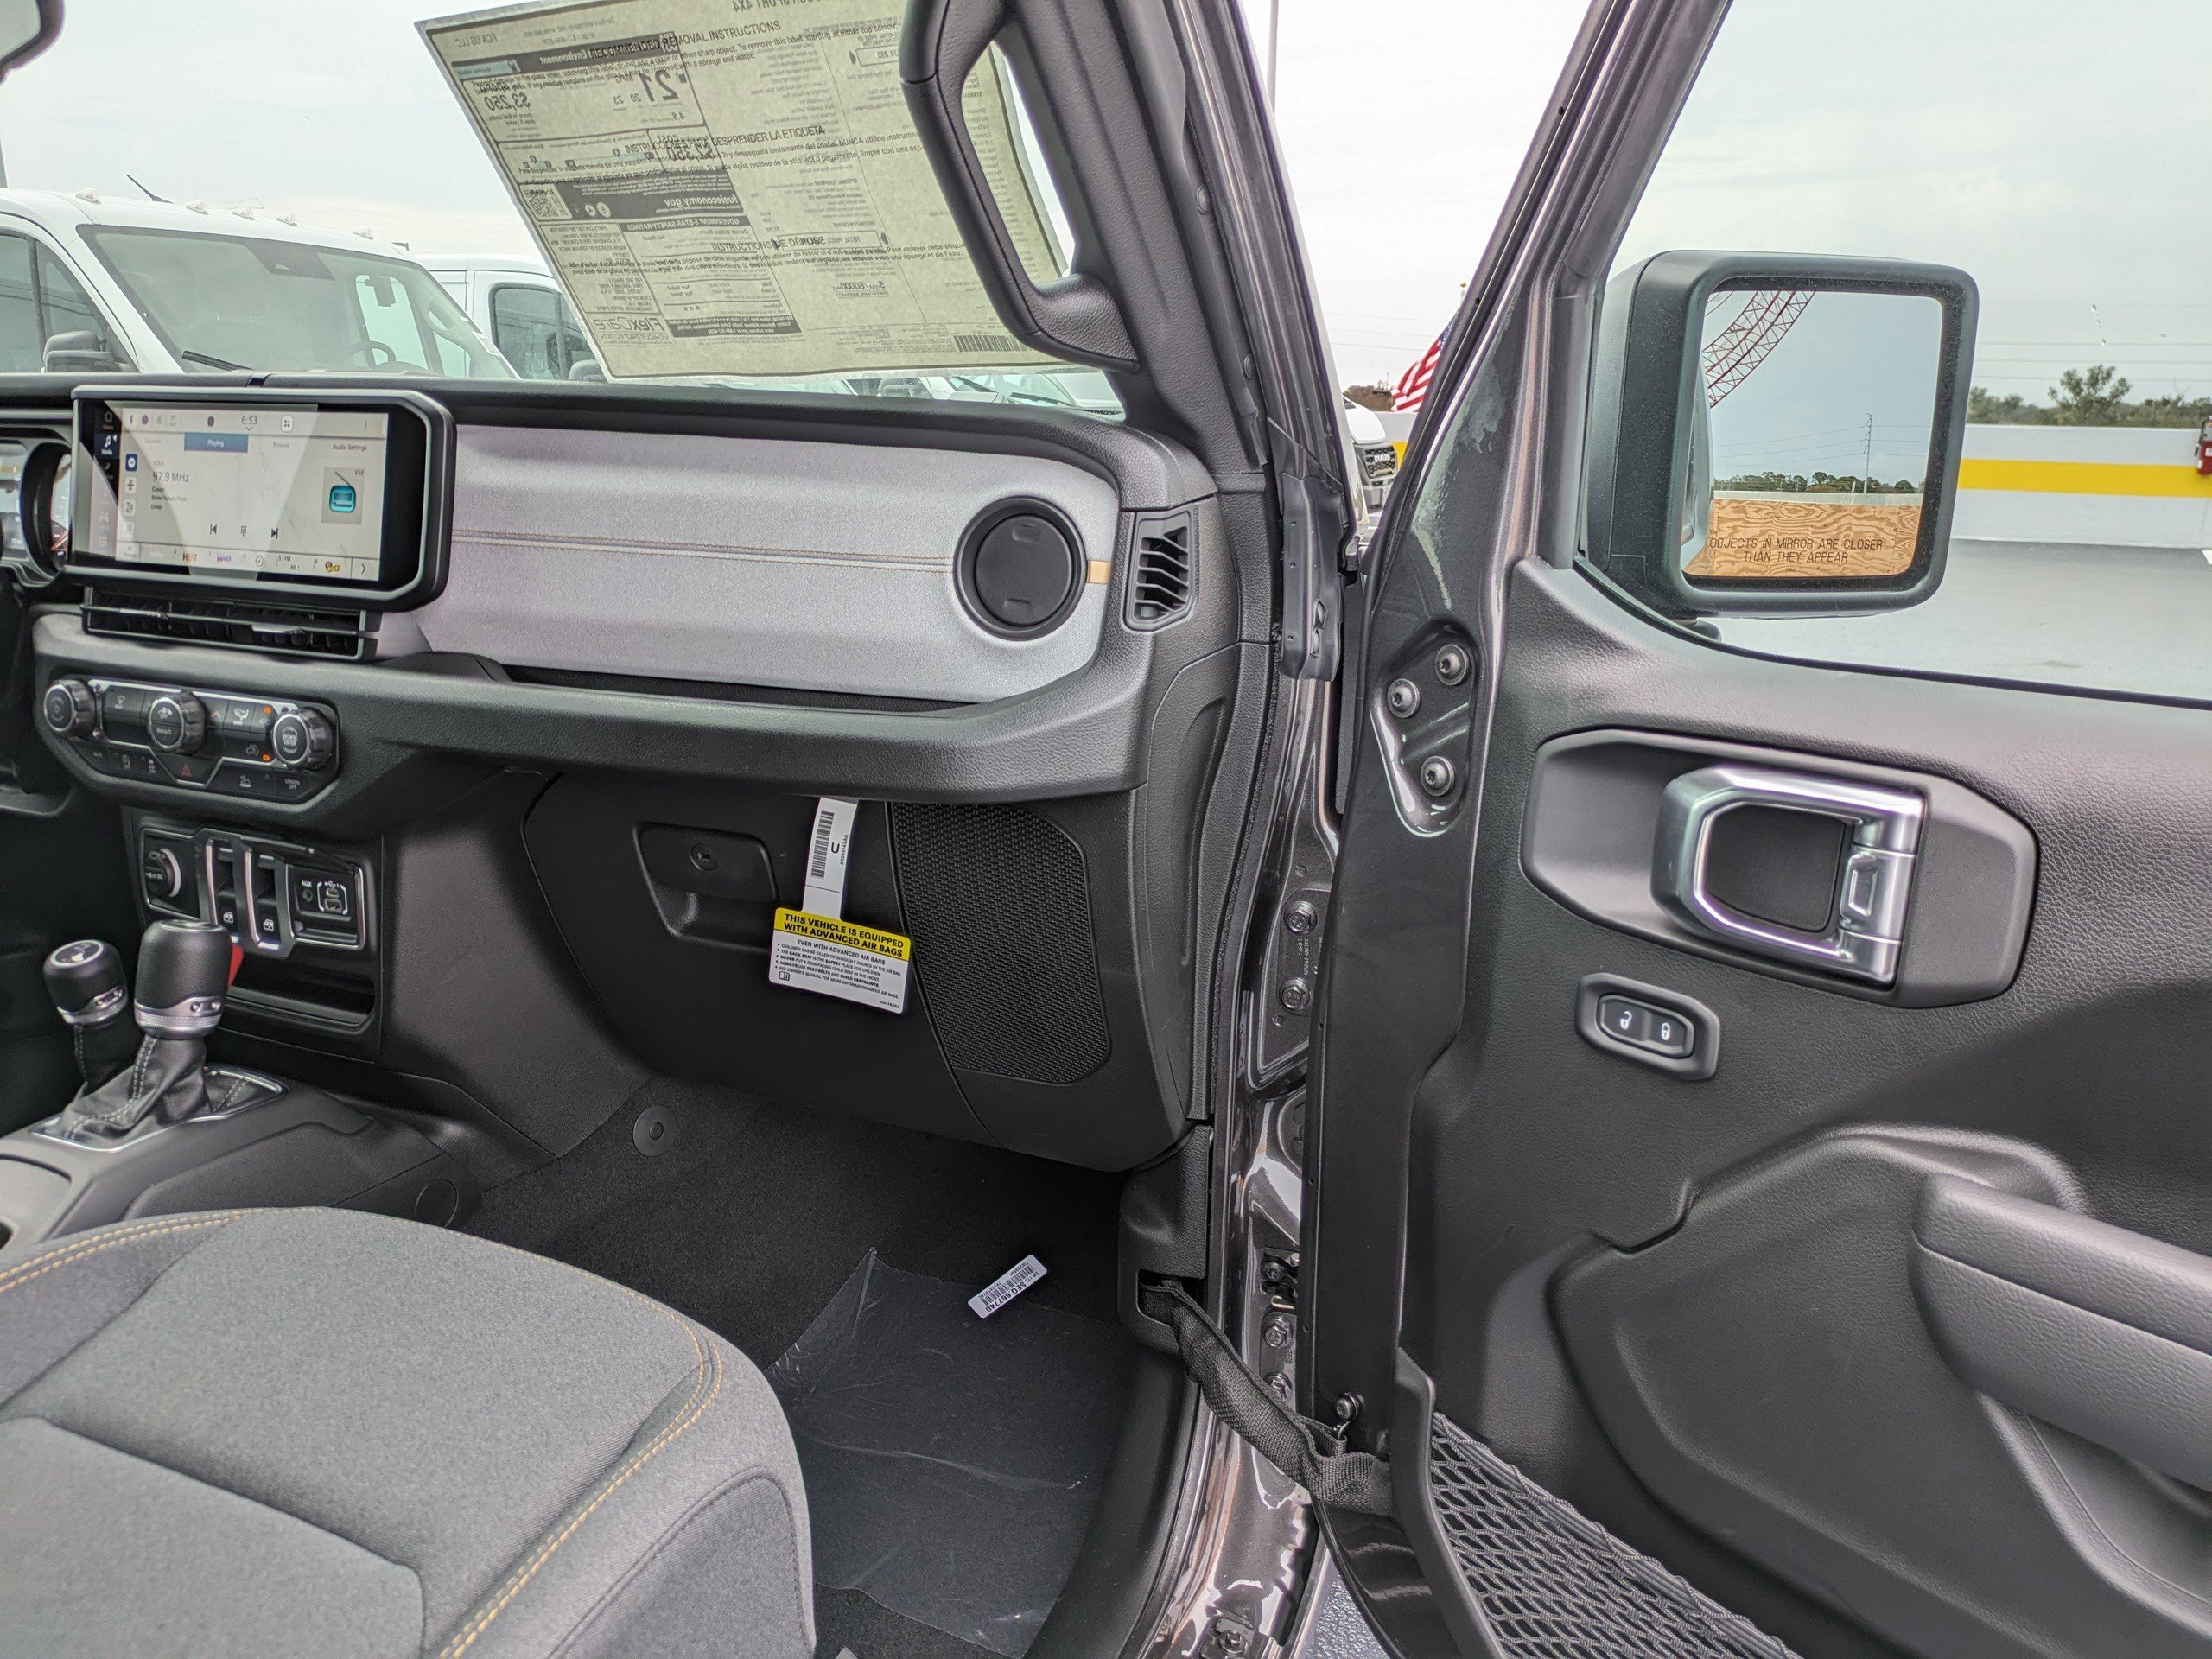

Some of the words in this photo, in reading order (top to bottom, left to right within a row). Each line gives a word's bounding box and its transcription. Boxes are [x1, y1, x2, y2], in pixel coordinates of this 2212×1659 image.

[591, 38, 660, 58] RECOMMENDED
[662, 30, 709, 48] REMOVAL
[709, 20, 781, 41] INSTRUCTIONS
[698, 48, 715, 58] sharp
[716, 42, 737, 56] object.
[737, 41, 747, 52] To
[747, 40, 772, 49] remove
[787, 34, 804, 44] label,
[805, 30, 831, 43] starting
[841, 27, 859, 35] either
[860, 26, 873, 35] top
[699, 58, 721, 67] sponge
[713, 131, 768, 146] DESPRENDER
[769, 130, 782, 140] LA
[783, 124, 825, 139] ETIQUETA
[770, 143, 804, 153] lentamente
[839, 137, 863, 146] NUNCA
[866, 133, 885, 143] utilice
[733, 162, 749, 170] algún
[789, 155, 815, 164] etiqueta
[860, 148, 880, 157] limpie
[711, 241, 772, 251] INSTRUCTIONS
[788, 234, 826, 245] DÉPOSE
[152, 471, 169, 481] 97.9
[172, 473, 189, 482] MHz
[1709, 537, 1758, 548] OBJECTS
[1762, 538, 1771, 548] IN
[1777, 538, 1814, 549] MIRROR
[1819, 539, 1838, 550] ARE
[1844, 539, 1883, 550] CLOSER
[1744, 551, 1771, 562] THAN
[1777, 551, 1802, 563] THEY
[1806, 552, 1848, 563] APPEAR
[831, 842, 840, 854] U
[784, 922, 808, 934] WITH
[810, 928, 860, 946] ADVANCED
[861, 939, 877, 950] AIR
[879, 944, 903, 956] BAGS
[785, 912, 805, 925] THIS
[808, 918, 846, 934] VEHICLE
[849, 928, 857, 937] IS
[859, 930, 904, 947] EQUIPPED
[798, 938, 812, 947] EVEN
[813, 943, 828, 951] WITH
[830, 946, 859, 958] ADVANCED
[871, 956, 885, 964] BAGS
[985, 1281, 1027, 1313] SEQ:667740
